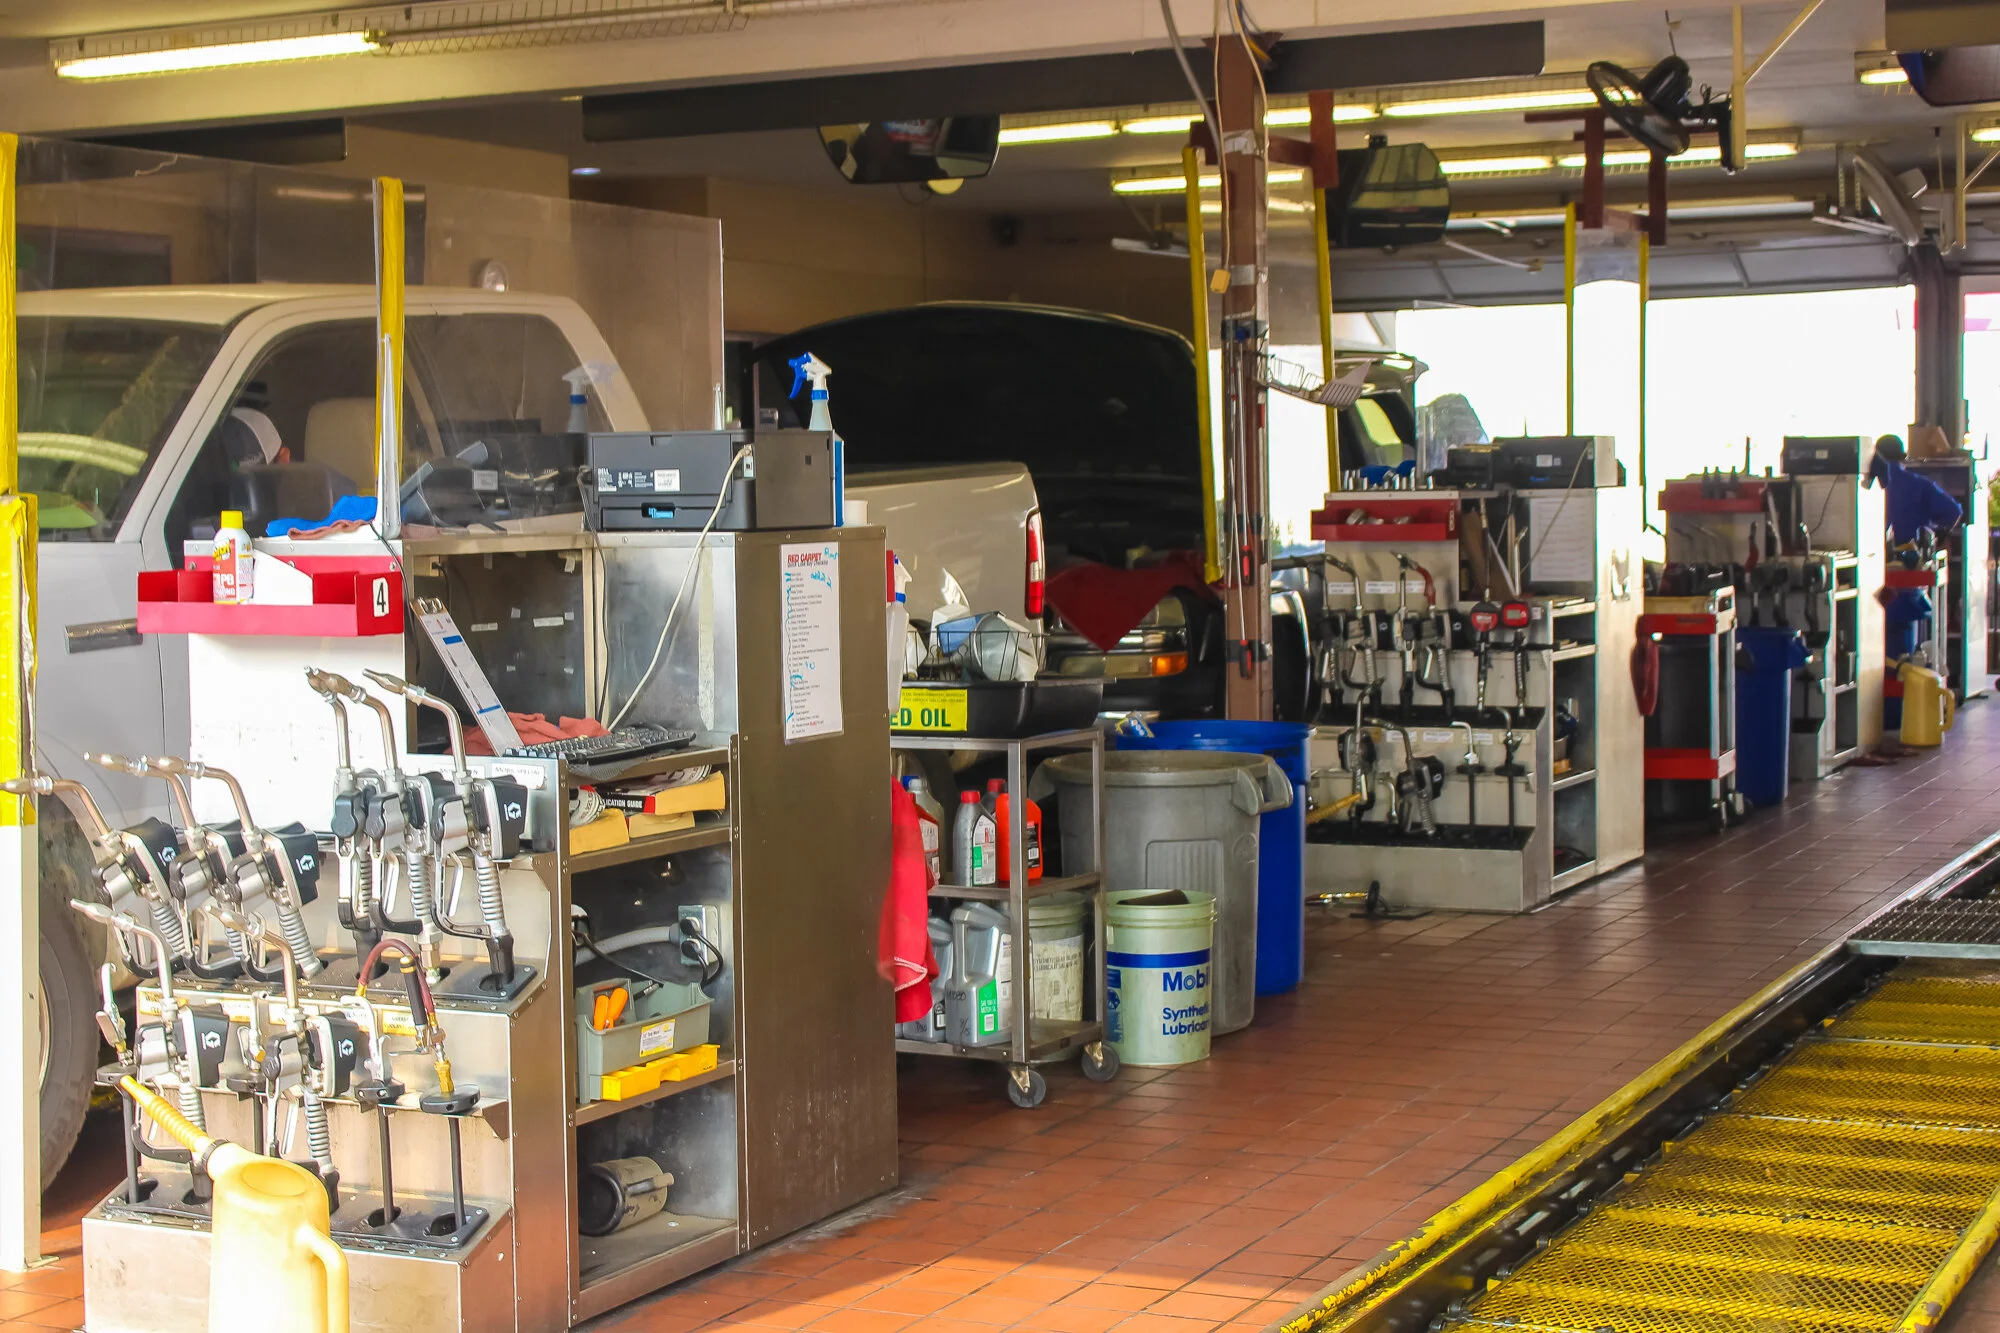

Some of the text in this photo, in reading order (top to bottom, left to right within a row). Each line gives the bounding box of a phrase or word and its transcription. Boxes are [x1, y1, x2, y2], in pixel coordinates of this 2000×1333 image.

[788, 554, 799, 563] RED
[800, 553, 822, 562] CARPET
[377, 582, 386, 613] 4
[920, 707, 951, 727] OIL
[627, 800, 643, 808] GUIDE
[1163, 966, 1210, 992] Mobi
